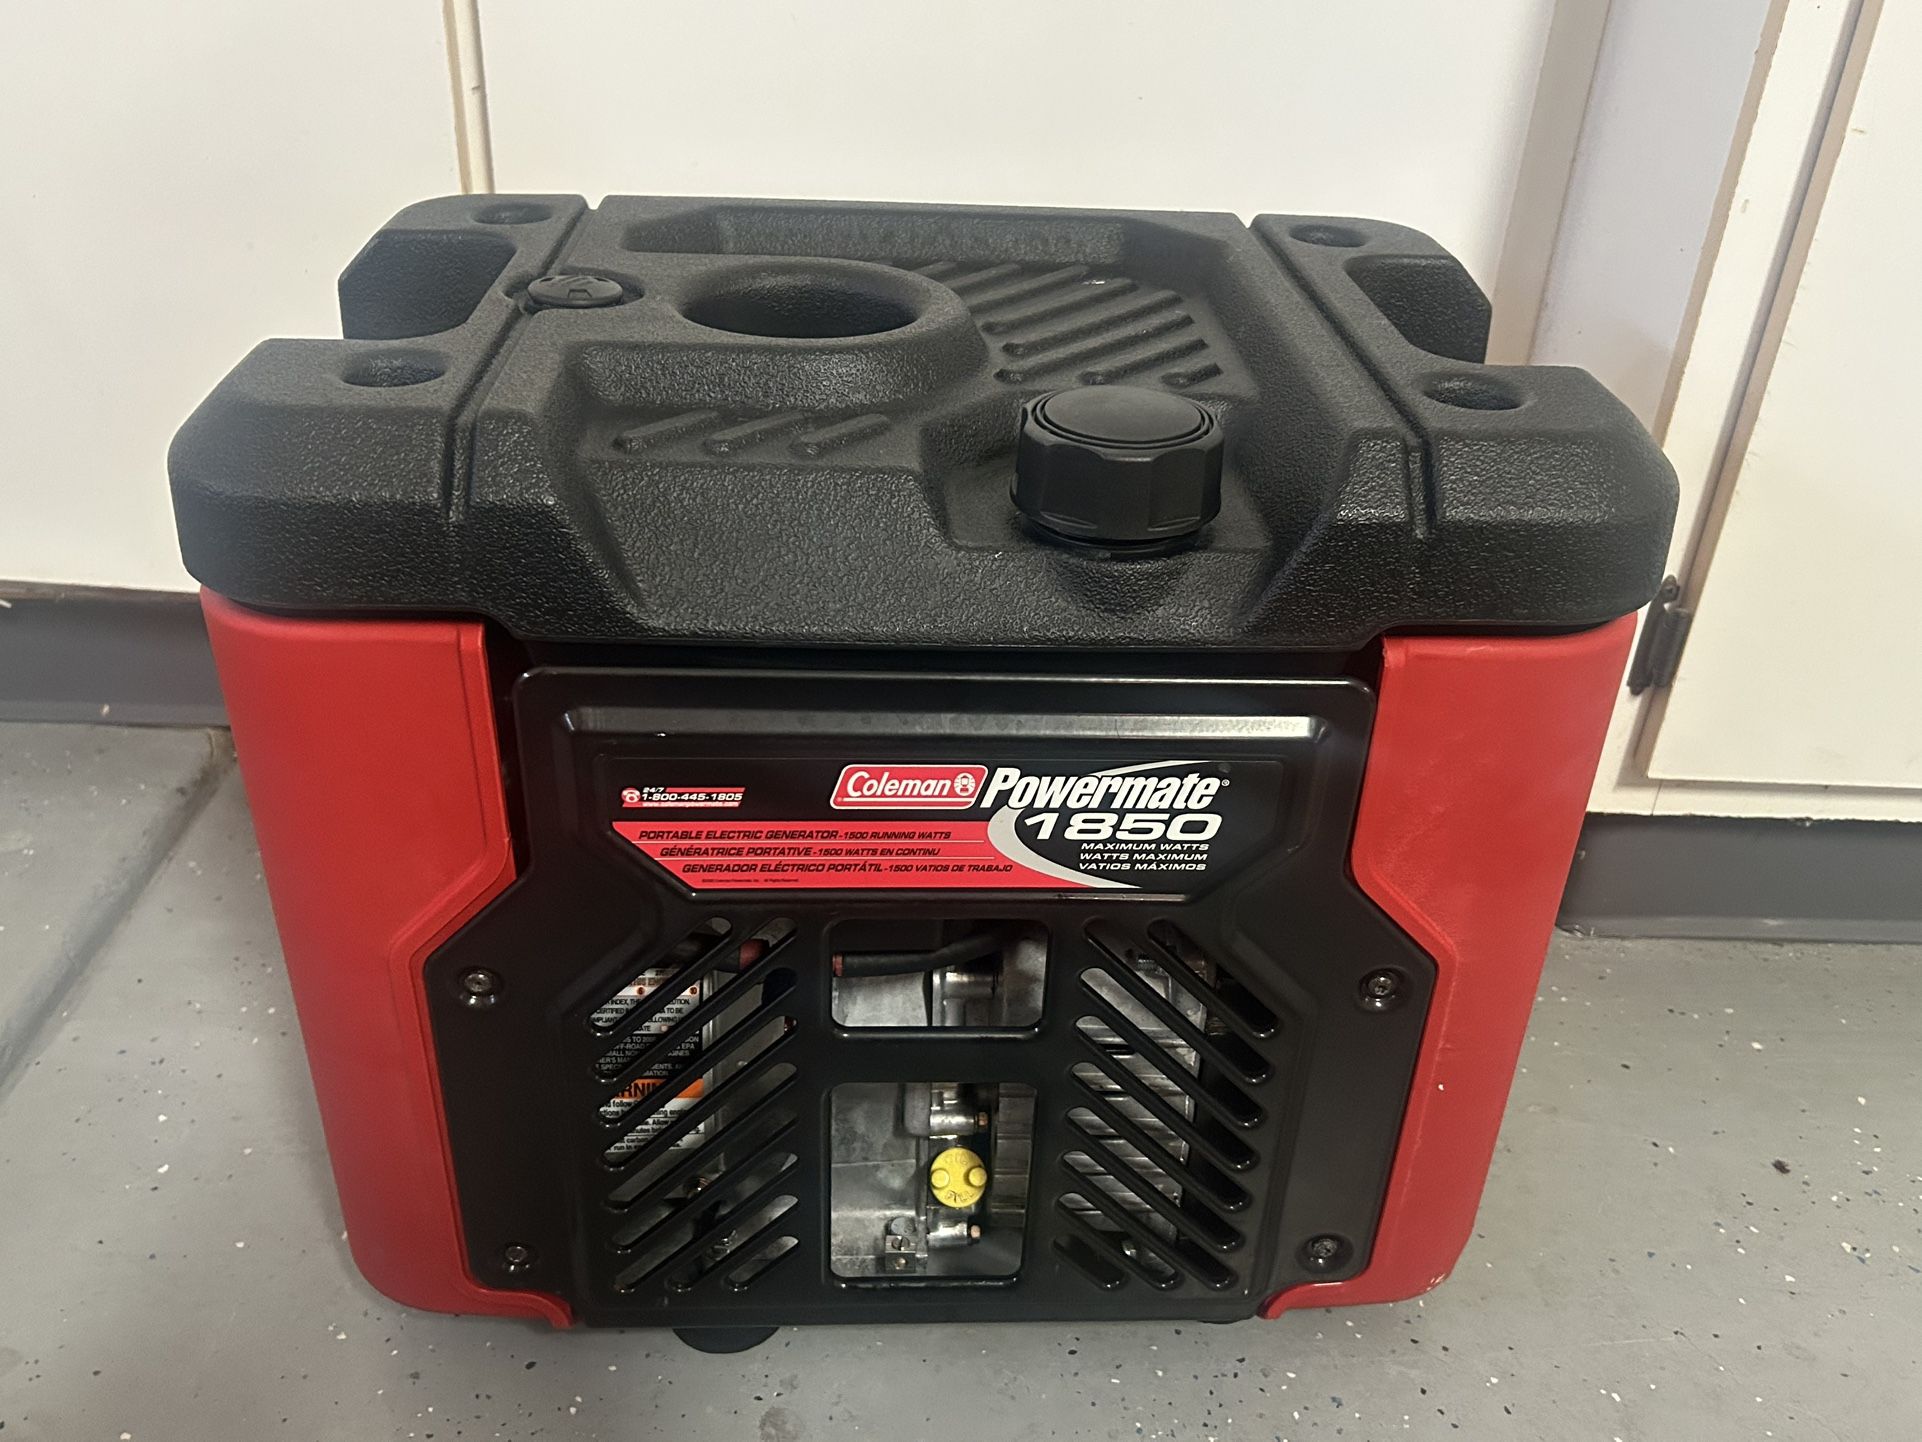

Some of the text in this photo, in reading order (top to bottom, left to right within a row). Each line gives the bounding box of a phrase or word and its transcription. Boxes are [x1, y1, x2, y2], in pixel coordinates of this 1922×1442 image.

[846, 771, 949, 797] Coleman
[641, 793, 744, 801] 1-800-445-1805
[1024, 812, 1223, 841] 1850
[639, 830, 704, 840] PORTABLE
[704, 830, 764, 840] ELECTRIC
[764, 830, 839, 840] GENERATOR
[869, 831, 916, 839] RUNNING
[917, 831, 952, 839] WATTS
[660, 845, 745, 857] GÉNÉRATRICE
[745, 846, 813, 857] PORTATIVE
[845, 848, 879, 856] WATTS
[879, 848, 895, 856] EN
[895, 848, 941, 856] CONTINU
[1081, 842, 1210, 851] MAXIMUM WATTS
[1080, 852, 1209, 861] WATTS MAXIMUM
[681, 863, 759, 873] GENERADOR
[759, 861, 826, 873] ELÉCTRICO
[826, 860, 883, 873] PORTÁTIL
[915, 864, 950, 872] VATIOS
[950, 864, 965, 872] DE
[966, 864, 1014, 872] TRABAJO
[1079, 861, 1207, 871] VATIOS MÁXIMOS
